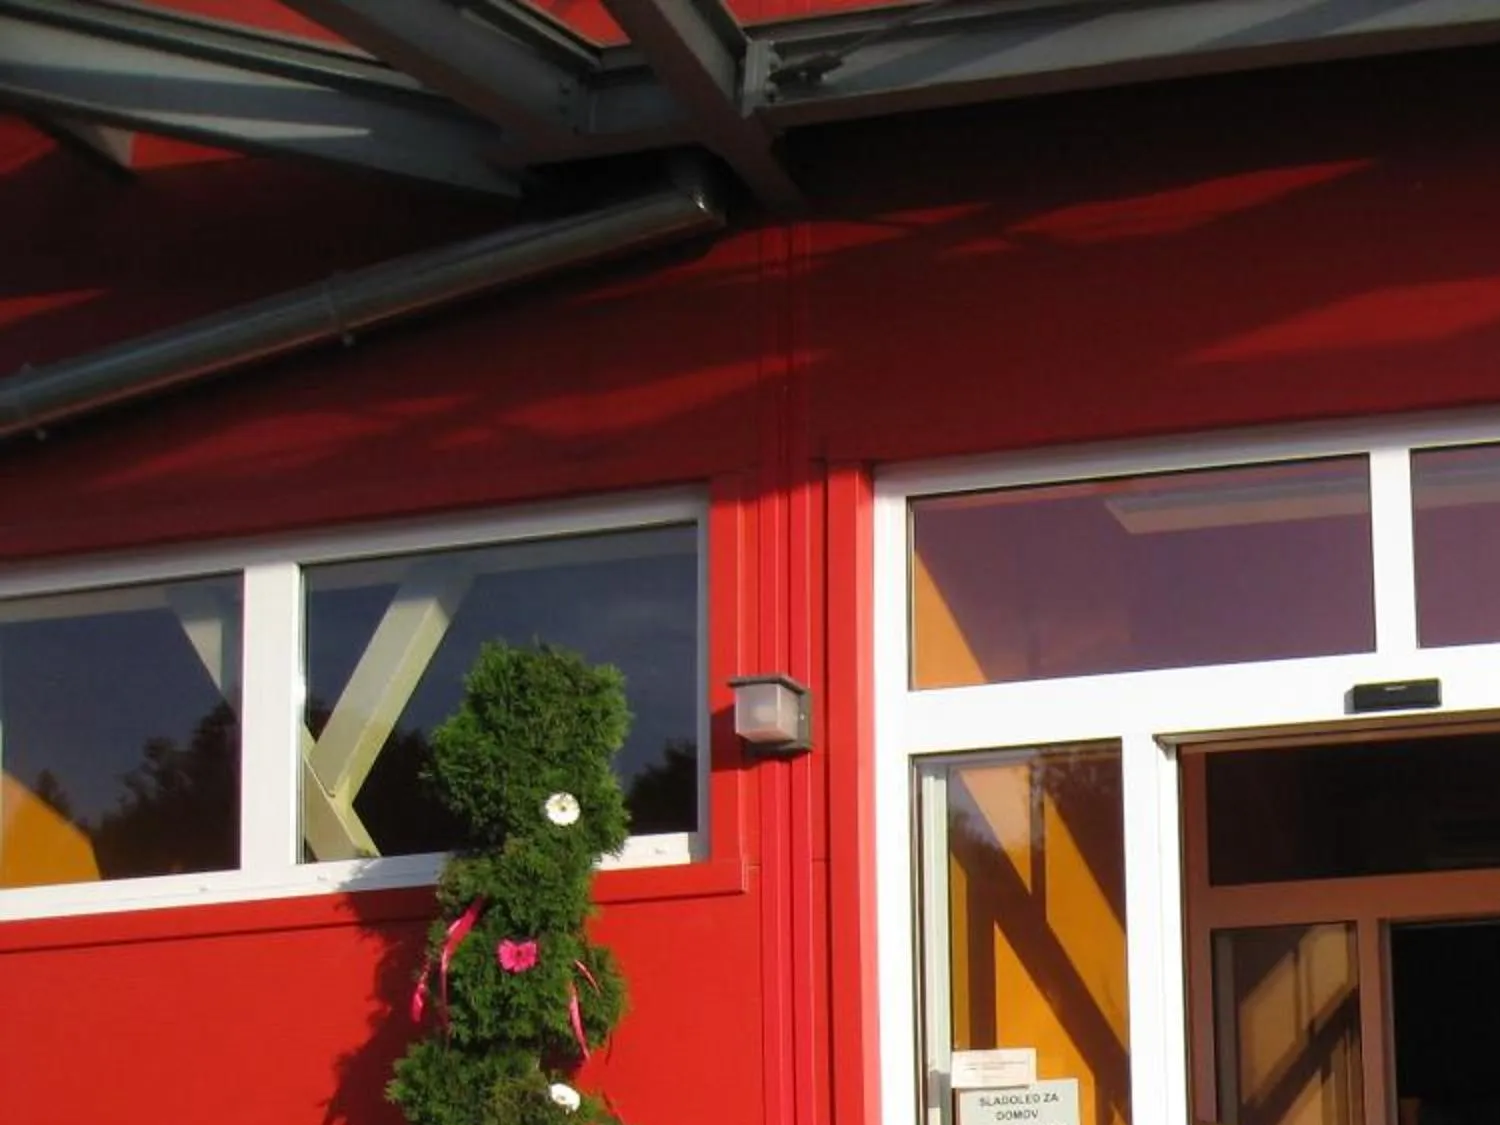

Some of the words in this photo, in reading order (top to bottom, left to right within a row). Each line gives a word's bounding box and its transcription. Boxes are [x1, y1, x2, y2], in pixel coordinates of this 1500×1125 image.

[979, 1092, 1041, 1107] SLADOLED
[1043, 1092, 1060, 1103] ZA
[995, 1109, 1039, 1121] DOMOV
